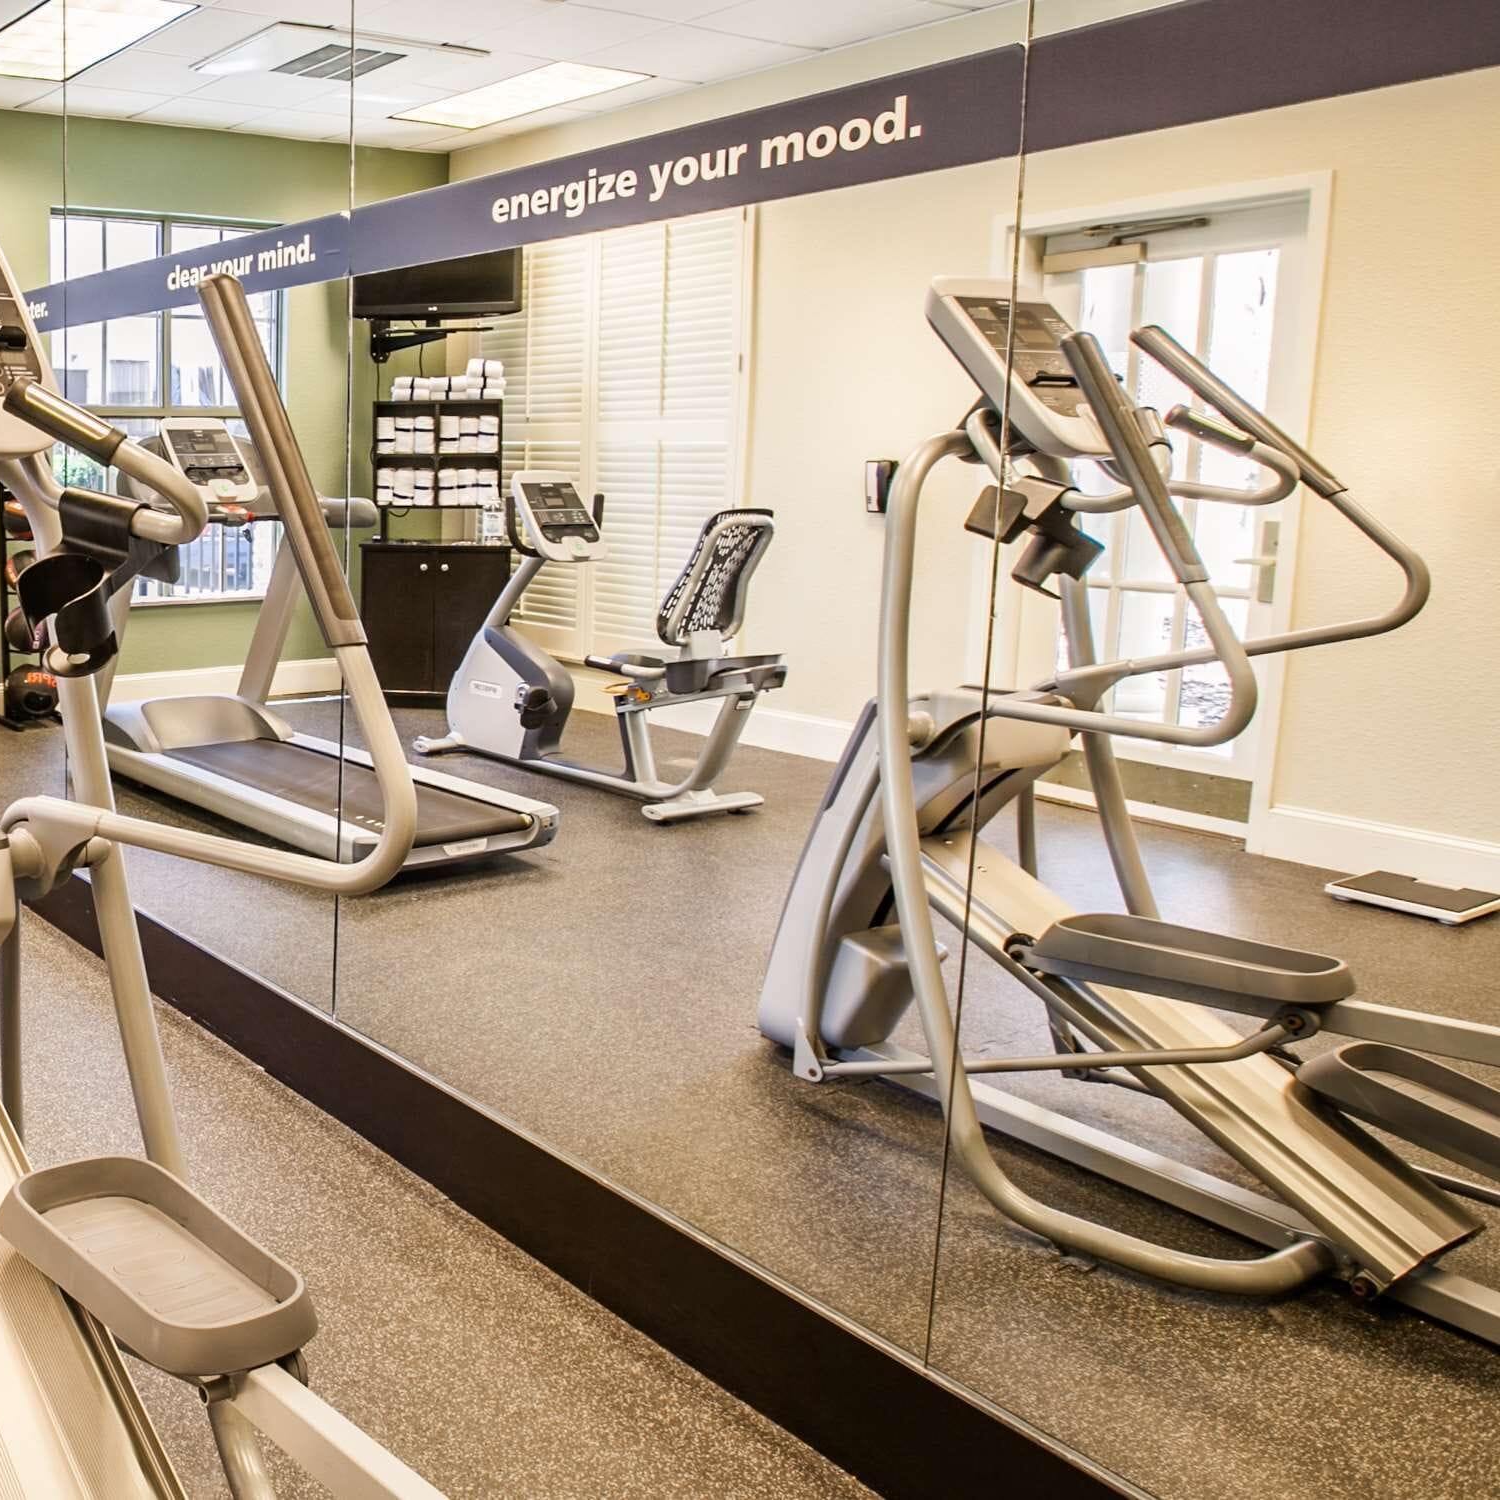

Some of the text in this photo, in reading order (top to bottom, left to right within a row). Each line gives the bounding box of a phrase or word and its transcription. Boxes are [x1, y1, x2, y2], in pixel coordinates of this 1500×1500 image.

[491, 95, 922, 224] energize your mood.
[167, 234, 316, 291] clear your mind.
[30, 301, 48, 320] ter.
